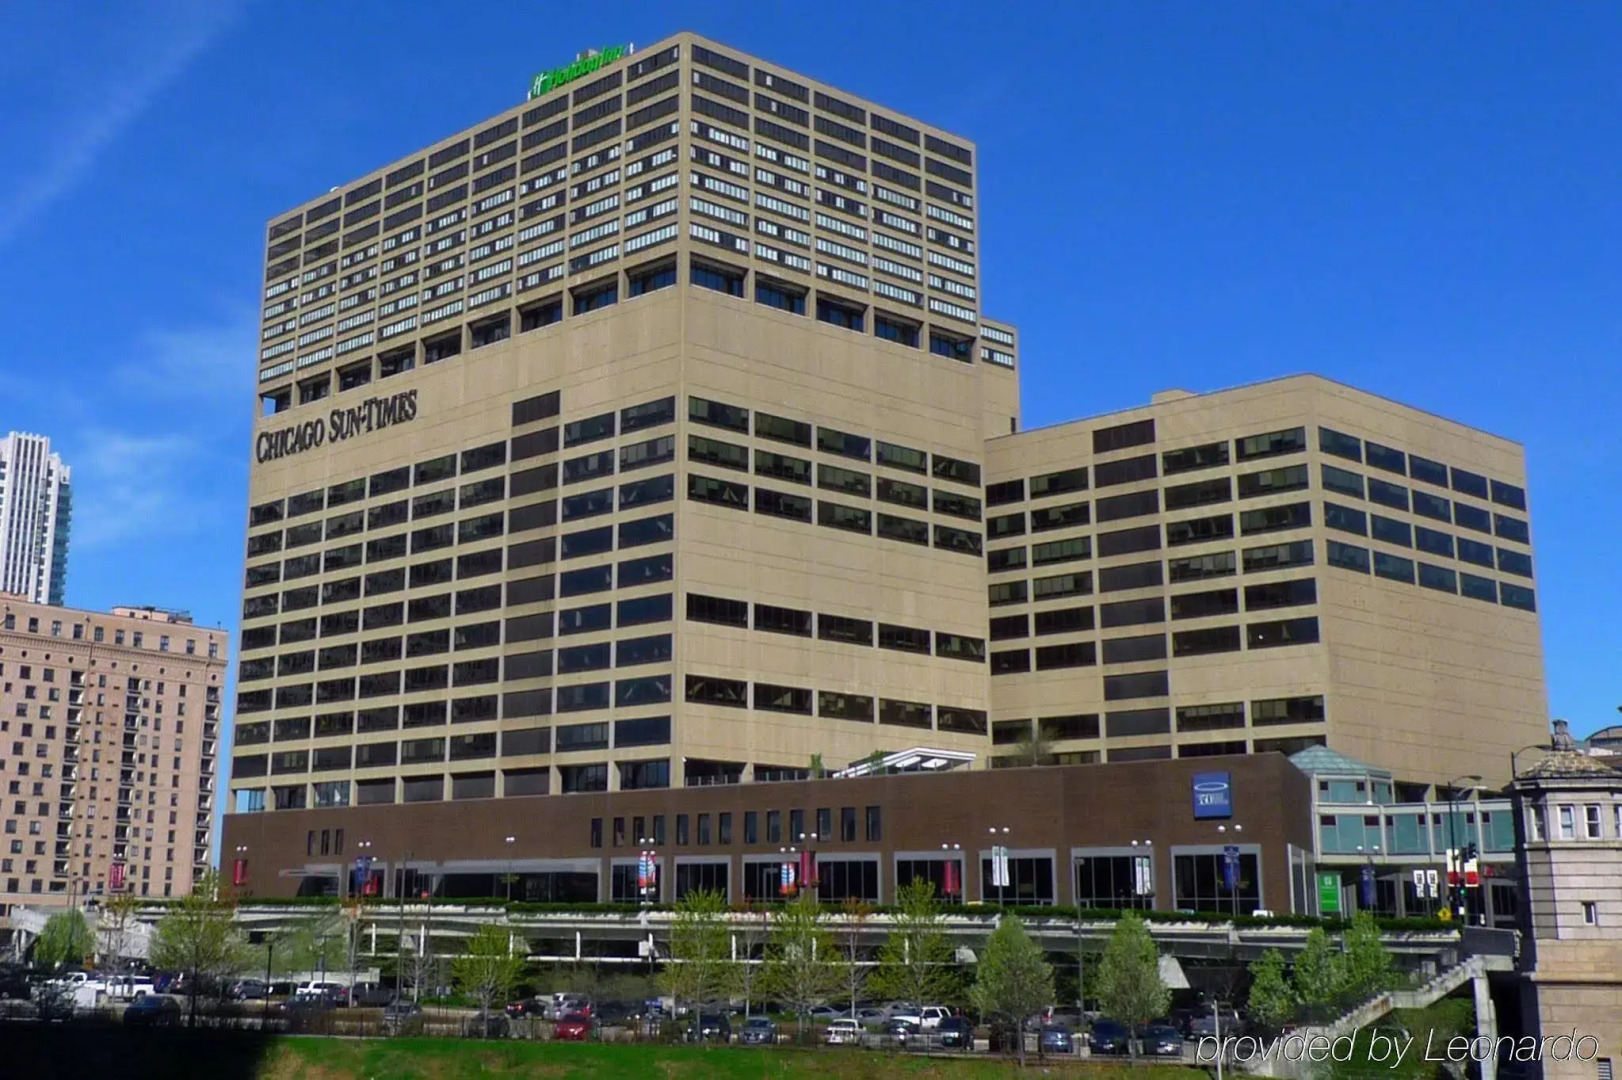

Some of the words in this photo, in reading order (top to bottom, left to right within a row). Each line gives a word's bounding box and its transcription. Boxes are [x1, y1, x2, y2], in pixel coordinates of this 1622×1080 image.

[551, 54, 602, 87] Holiday
[602, 45, 625, 65] Inn
[256, 418, 326, 463] CHICAGO
[329, 389, 418, 443] SUN-TIMES
